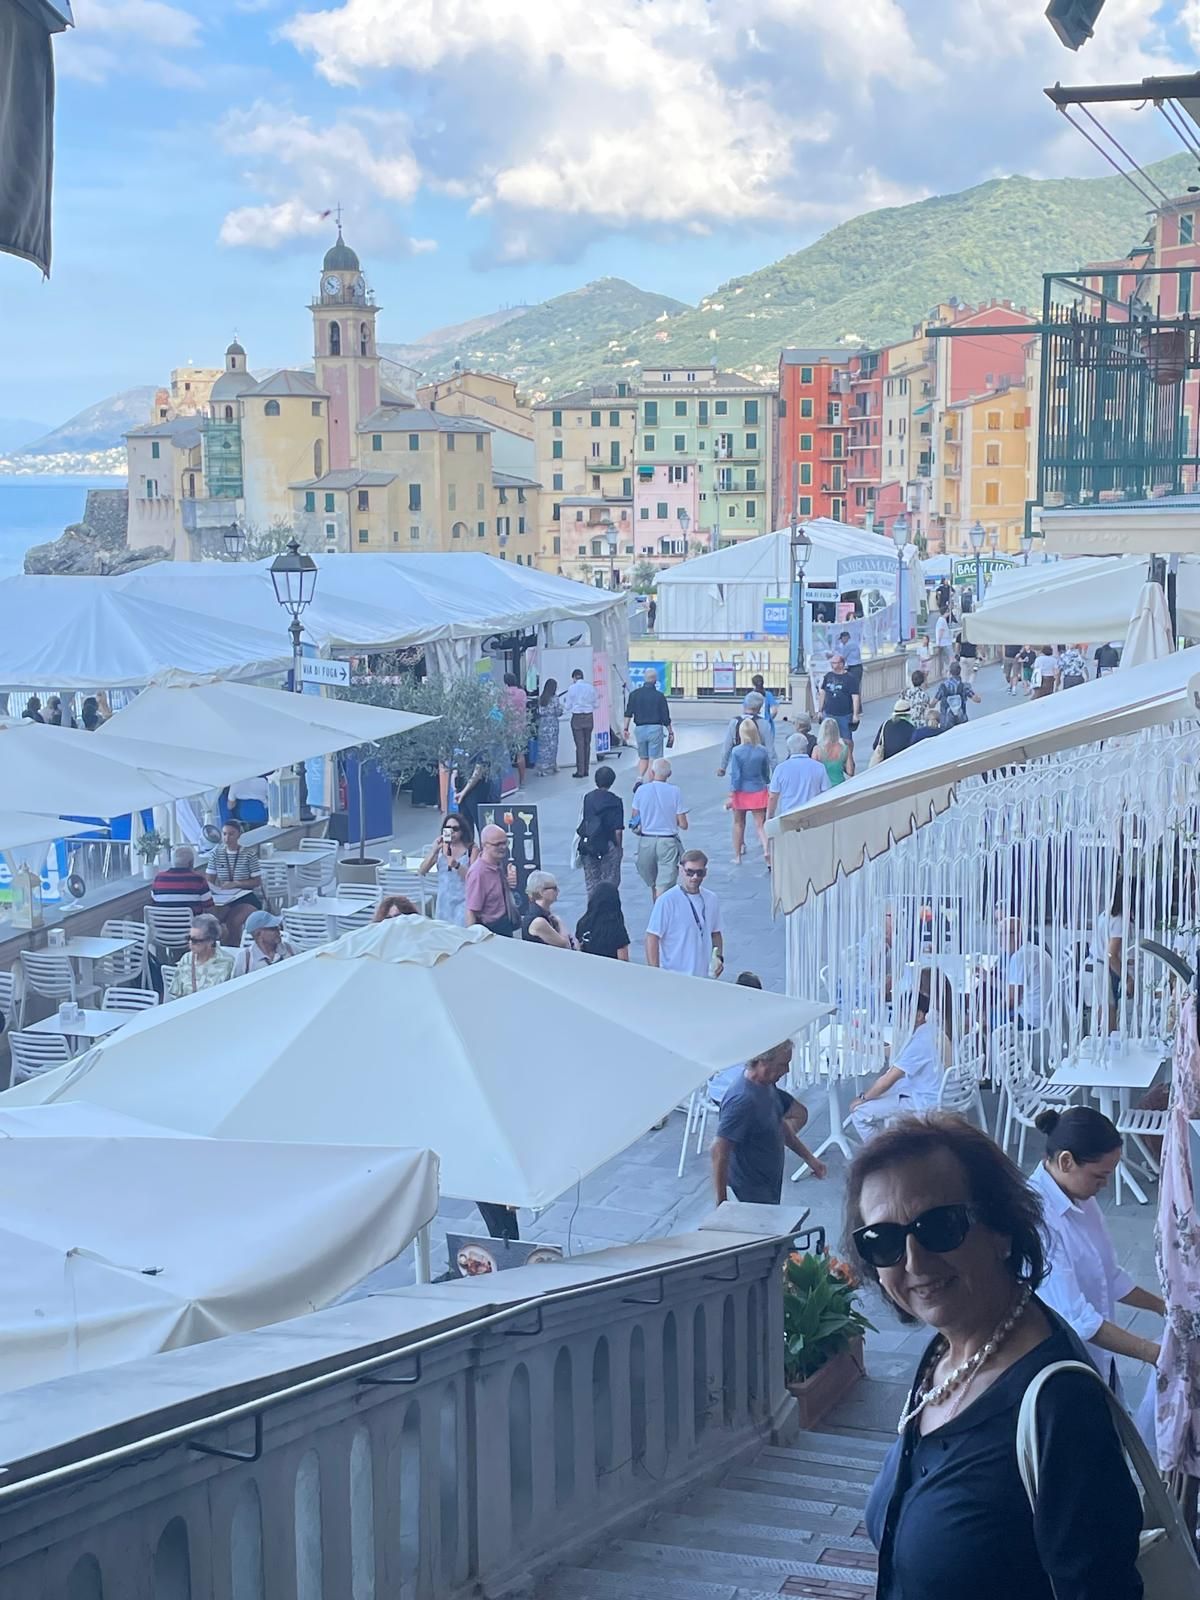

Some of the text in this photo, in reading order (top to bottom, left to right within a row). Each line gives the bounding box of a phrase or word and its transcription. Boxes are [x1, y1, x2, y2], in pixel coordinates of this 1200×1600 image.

[957, 562, 987, 575] BAGI
[692, 650, 771, 671] BAGNI
[303, 663, 338, 678] VIA DI FUGA
